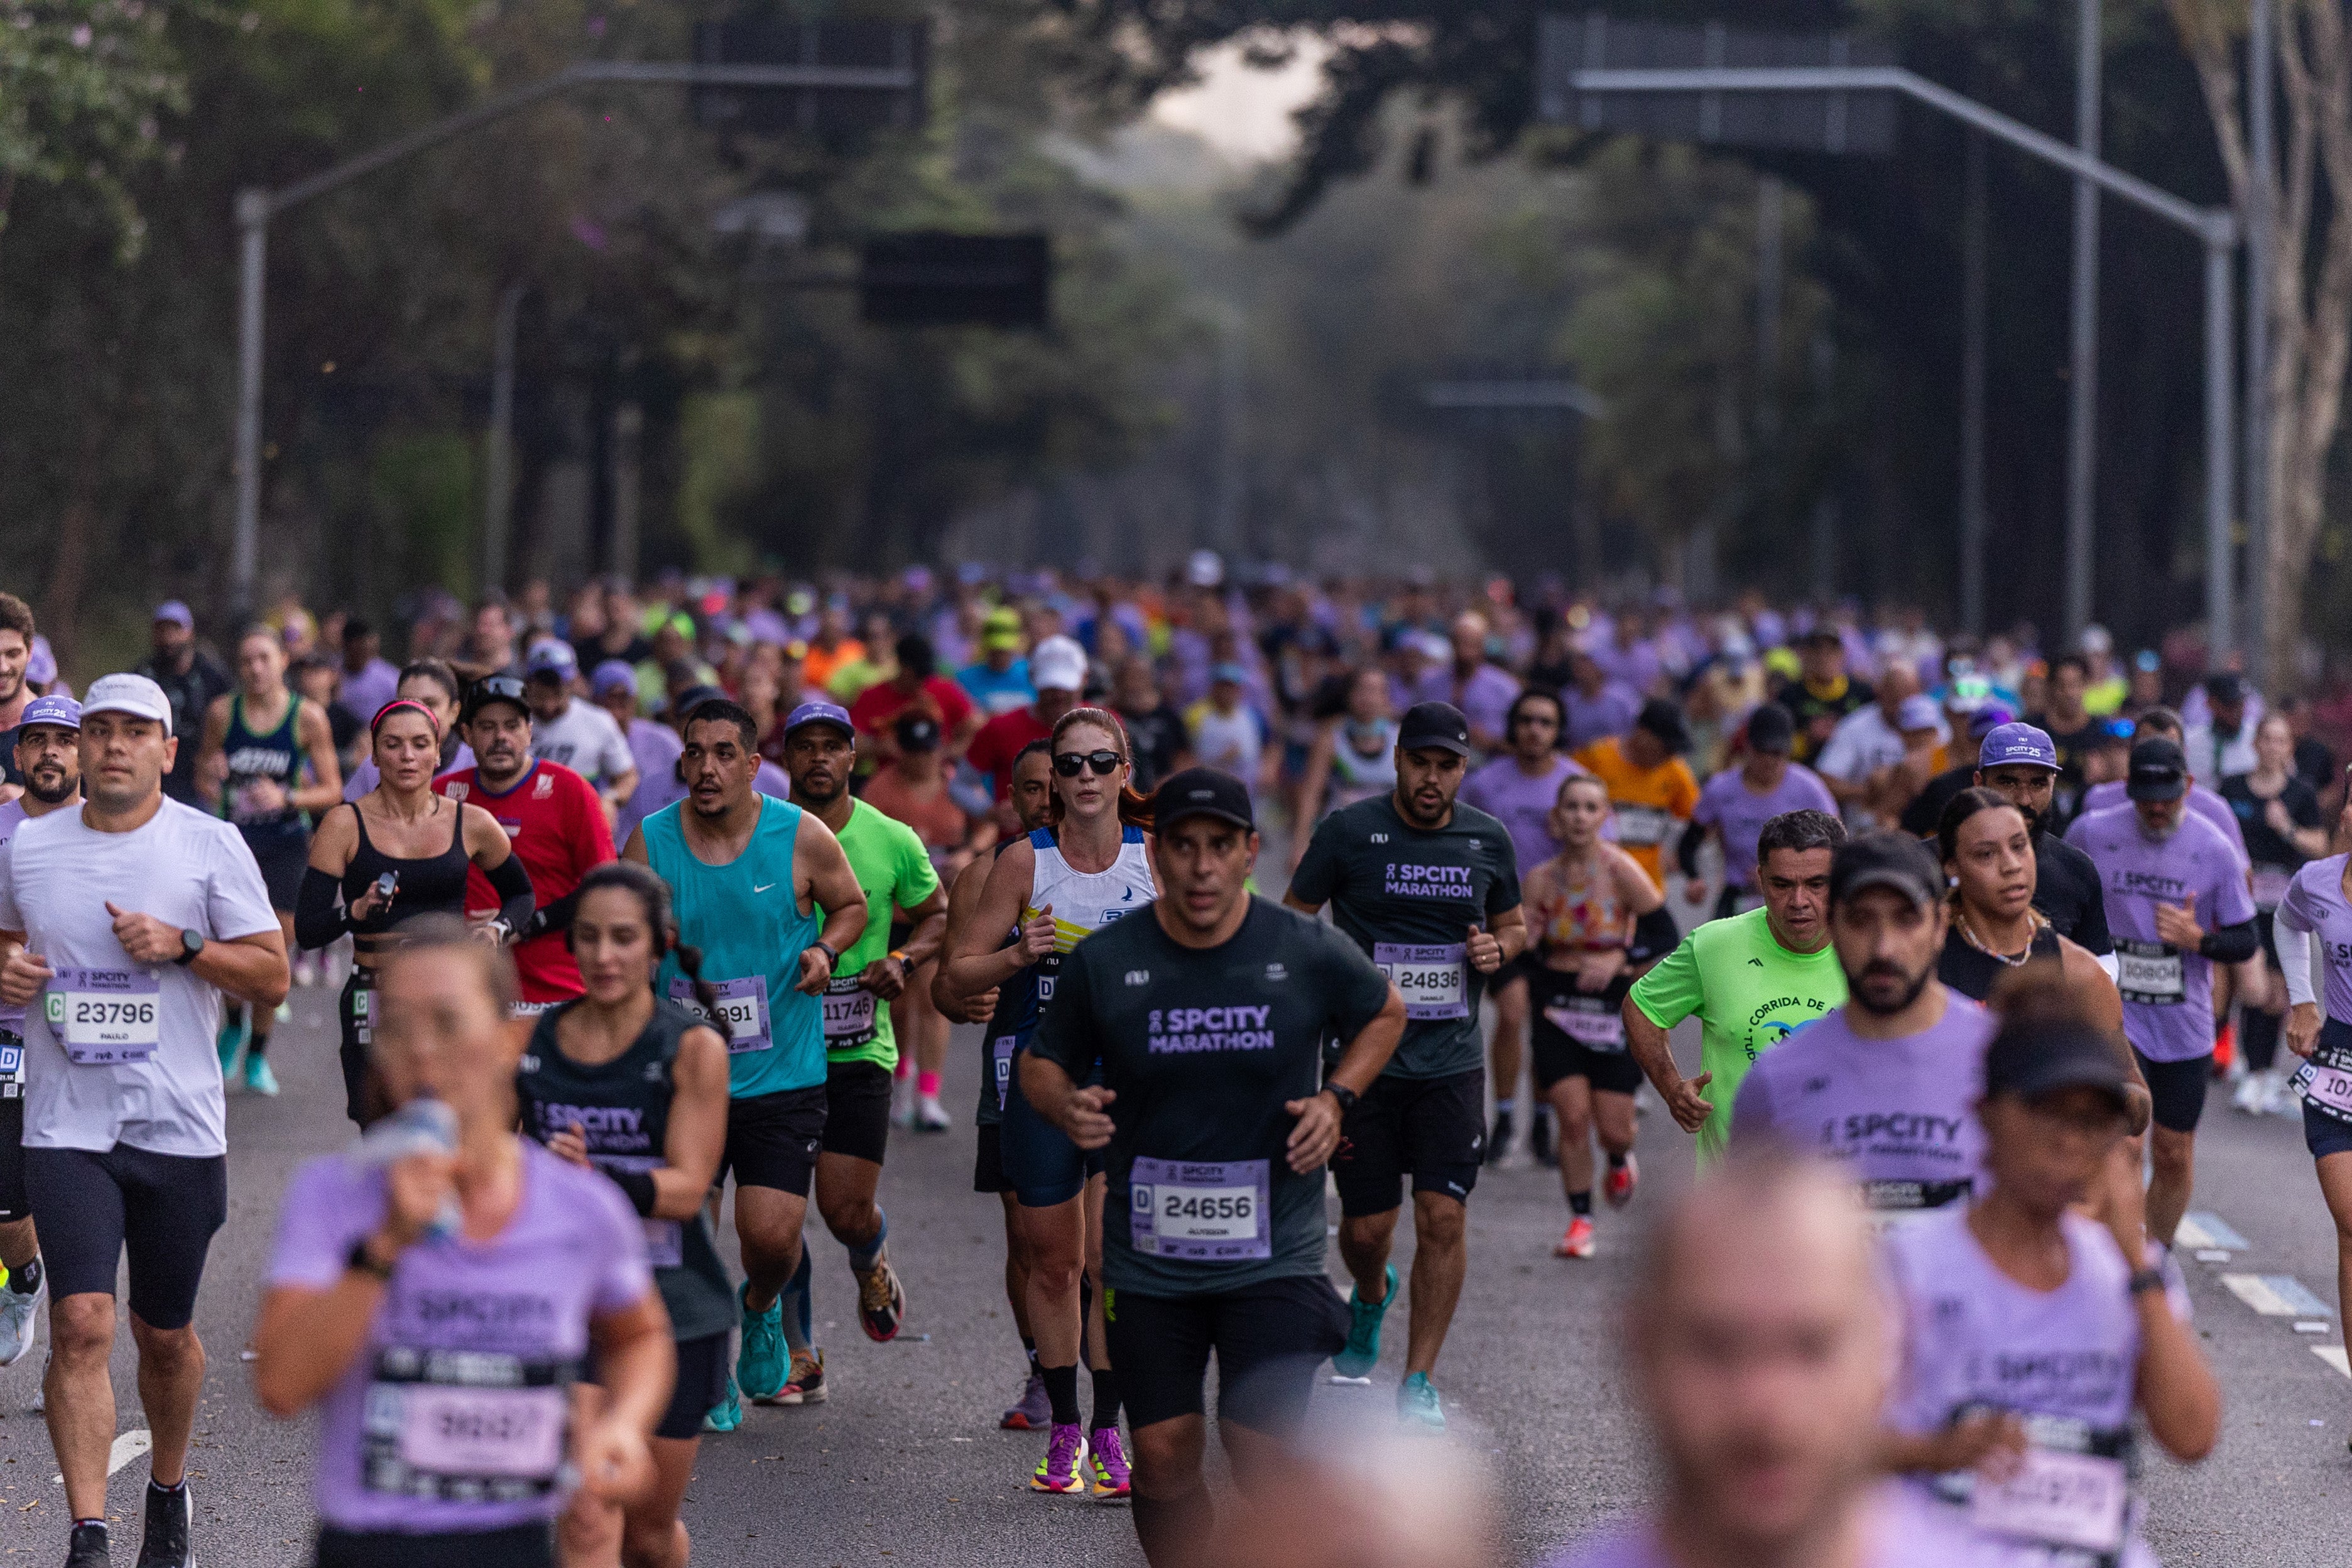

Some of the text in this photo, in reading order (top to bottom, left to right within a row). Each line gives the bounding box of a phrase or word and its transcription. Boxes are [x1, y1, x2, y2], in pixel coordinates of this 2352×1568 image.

[53, 709, 66, 718] 25
[2028, 746, 2040, 758] 25
[1400, 864, 1471, 883] SPCITY
[1385, 881, 1473, 898] MARATHON
[1415, 947, 1446, 956] SPCITY
[91, 971, 131, 981] SPCITY
[1401, 970, 1459, 989] 24836
[1041, 980, 1052, 996] D
[50, 998, 62, 1017] C
[76, 1002, 154, 1024] 23796
[824, 996, 871, 1020] 11746
[1750, 996, 1825, 1026] CORRIDA DE
[1167, 1005, 1271, 1033] SPCITY
[1148, 1030, 1275, 1055] MARATHON
[4, 1052, 15, 1065] D
[1844, 1112, 1961, 1142] SPCITY
[1165, 1195, 1252, 1219] 24656
